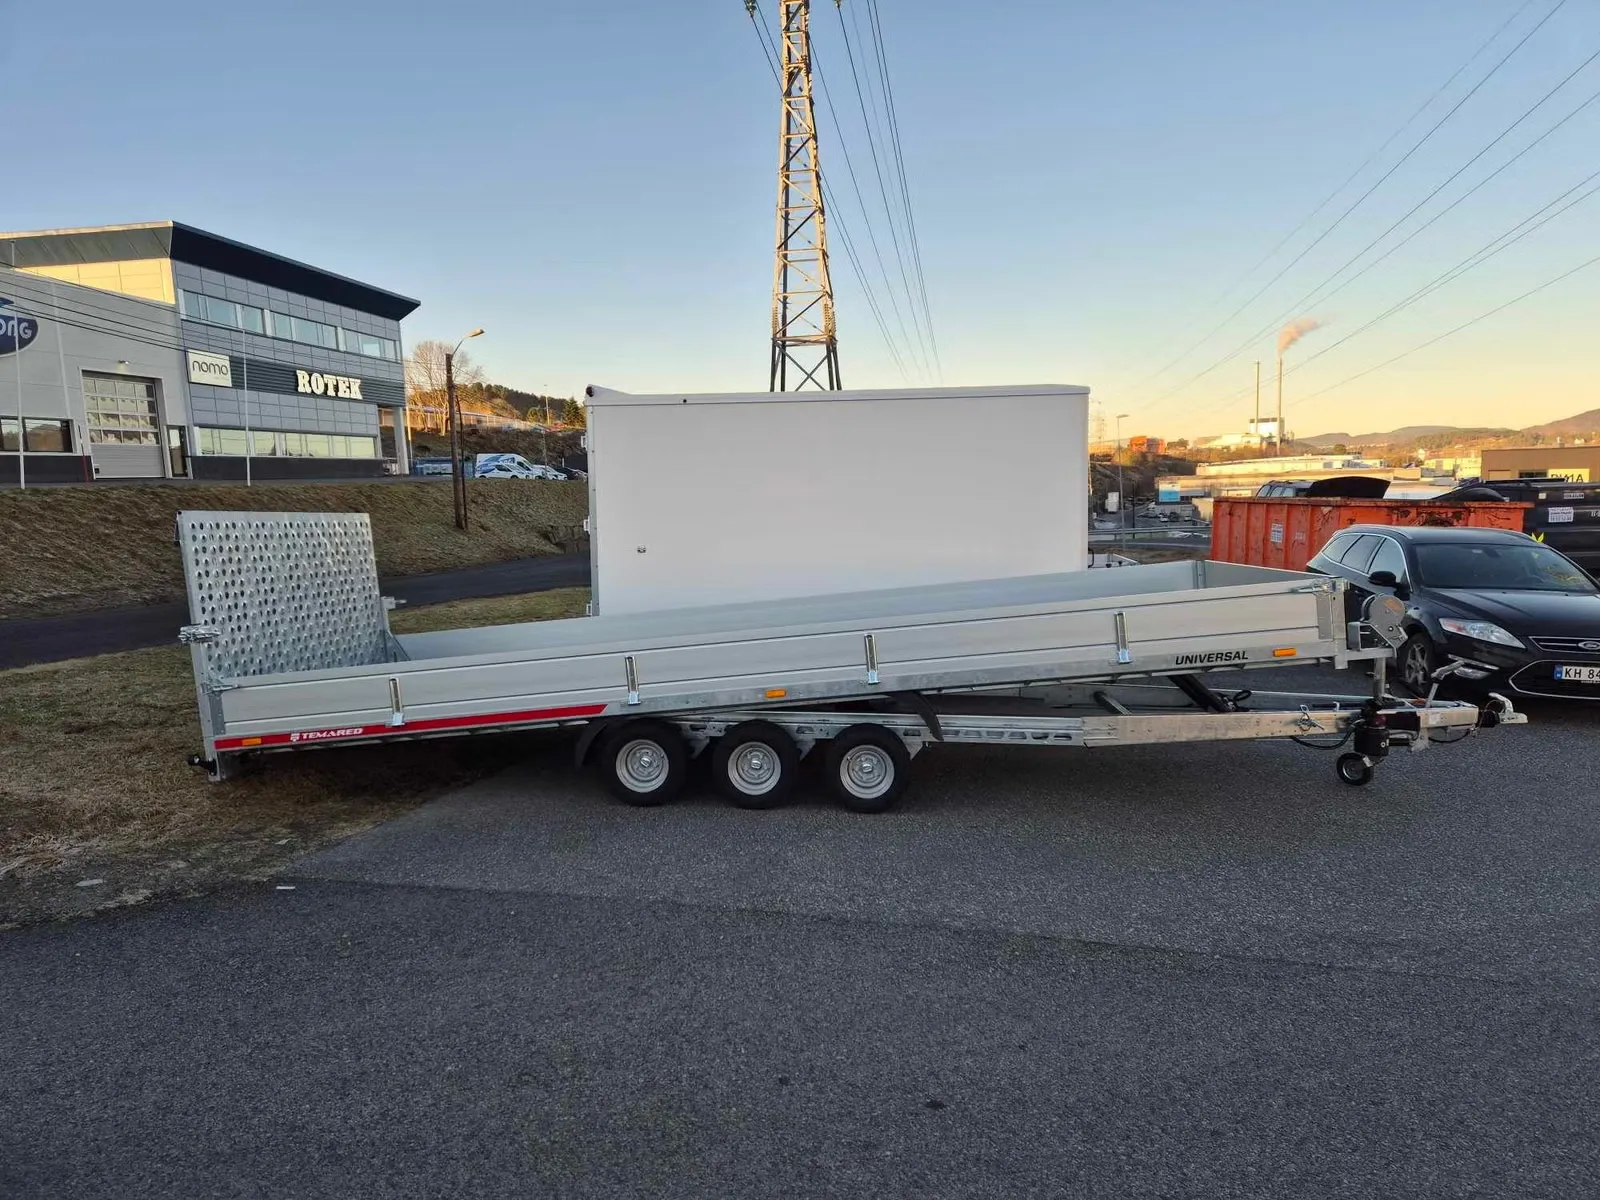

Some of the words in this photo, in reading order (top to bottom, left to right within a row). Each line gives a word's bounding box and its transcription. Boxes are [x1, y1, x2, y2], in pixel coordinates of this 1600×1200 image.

[192, 360, 229, 376] nomo
[296, 369, 363, 400] ROTEK
[1175, 650, 1249, 666] UNIVERSAL
[1564, 667, 1582, 679] KH
[301, 727, 364, 740] TEMARED
